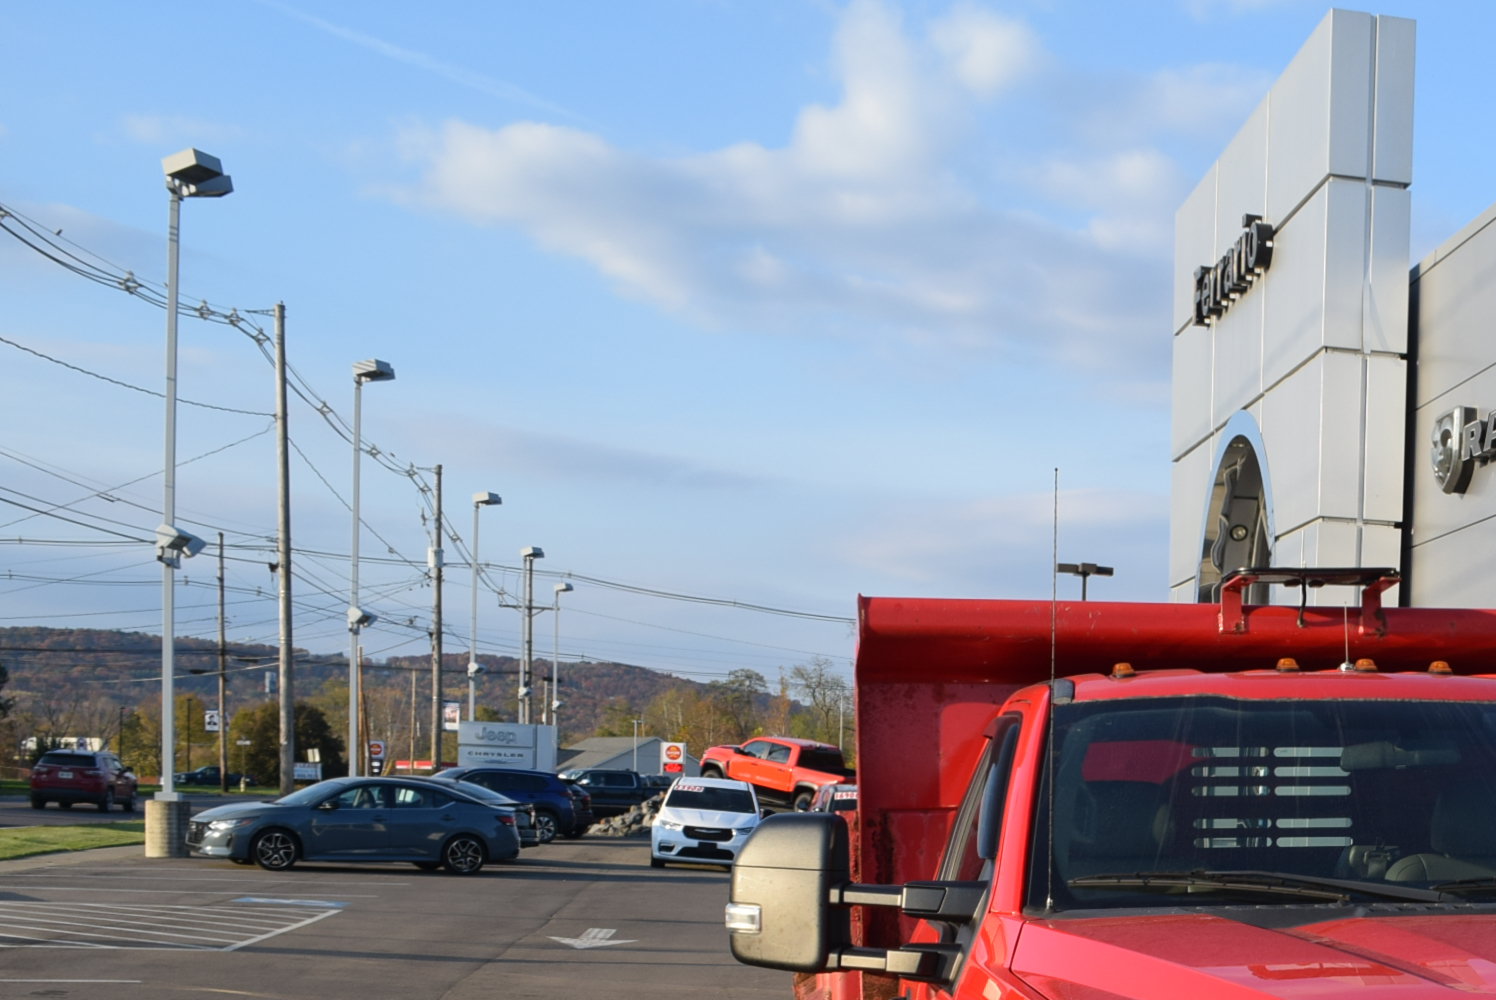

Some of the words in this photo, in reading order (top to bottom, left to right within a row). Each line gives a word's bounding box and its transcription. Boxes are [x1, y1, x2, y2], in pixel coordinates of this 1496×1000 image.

[1193, 213, 1274, 329] Ferrario
[475, 726, 517, 744] Jeep
[466, 750, 525, 758] CHRYSLER
